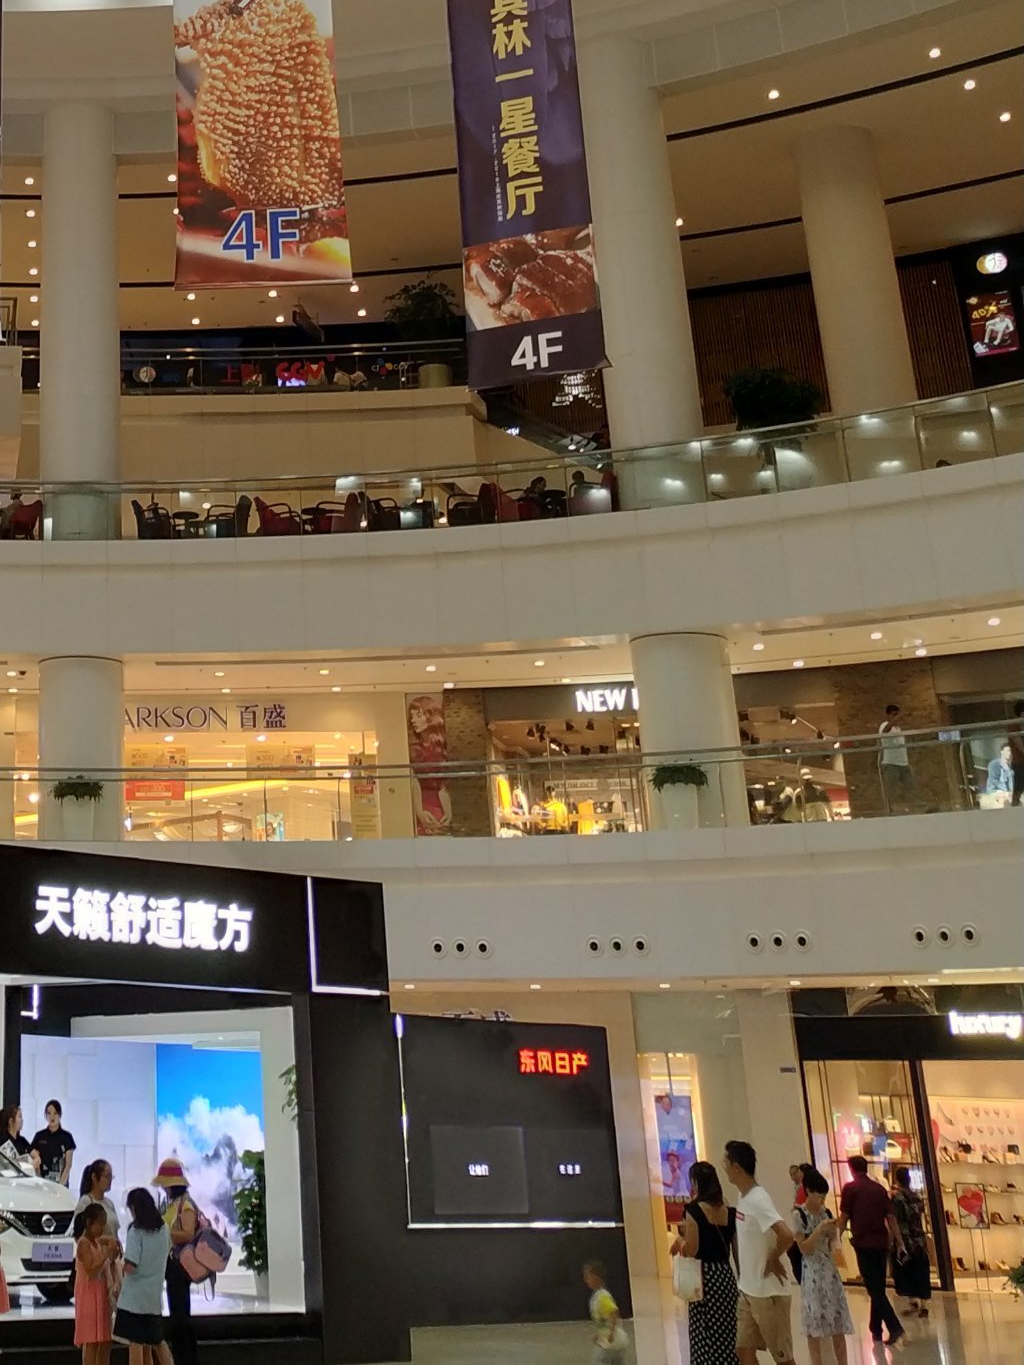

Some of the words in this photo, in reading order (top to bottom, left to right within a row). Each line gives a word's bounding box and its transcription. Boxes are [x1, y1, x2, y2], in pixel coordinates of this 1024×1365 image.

[220, 206, 300, 262] 4F
[511, 331, 563, 370] 4F
[575, 688, 626, 712] NEW
[125, 706, 228, 728] ARKSON
[236, 704, 287, 729] 百盛
[34, 884, 254, 953] 天籁舒适魔方
[518, 1049, 589, 1075] 东风日产
